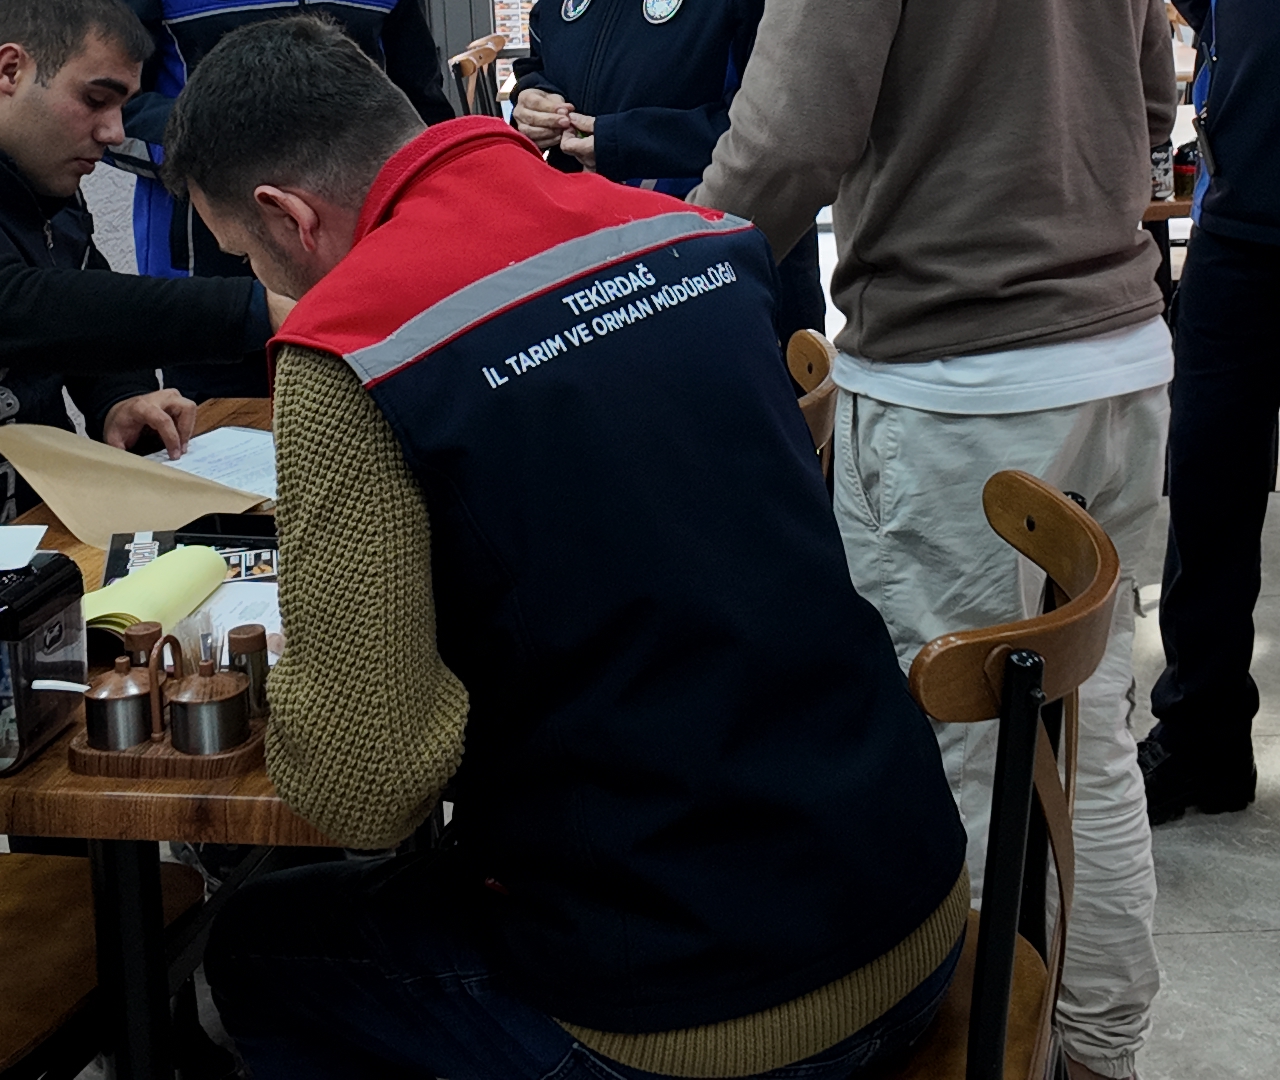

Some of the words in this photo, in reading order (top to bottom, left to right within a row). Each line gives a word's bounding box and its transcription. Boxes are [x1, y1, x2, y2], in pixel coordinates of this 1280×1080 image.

[482, 365, 509, 389] İL
[505, 334, 568, 375] TARIM
[564, 322, 594, 347] VE
[591, 297, 654, 336] ORMAN
[650, 261, 737, 313] MÜDÜRLÜĞÜ
[562, 262, 656, 316] TEKİRDAĞ
